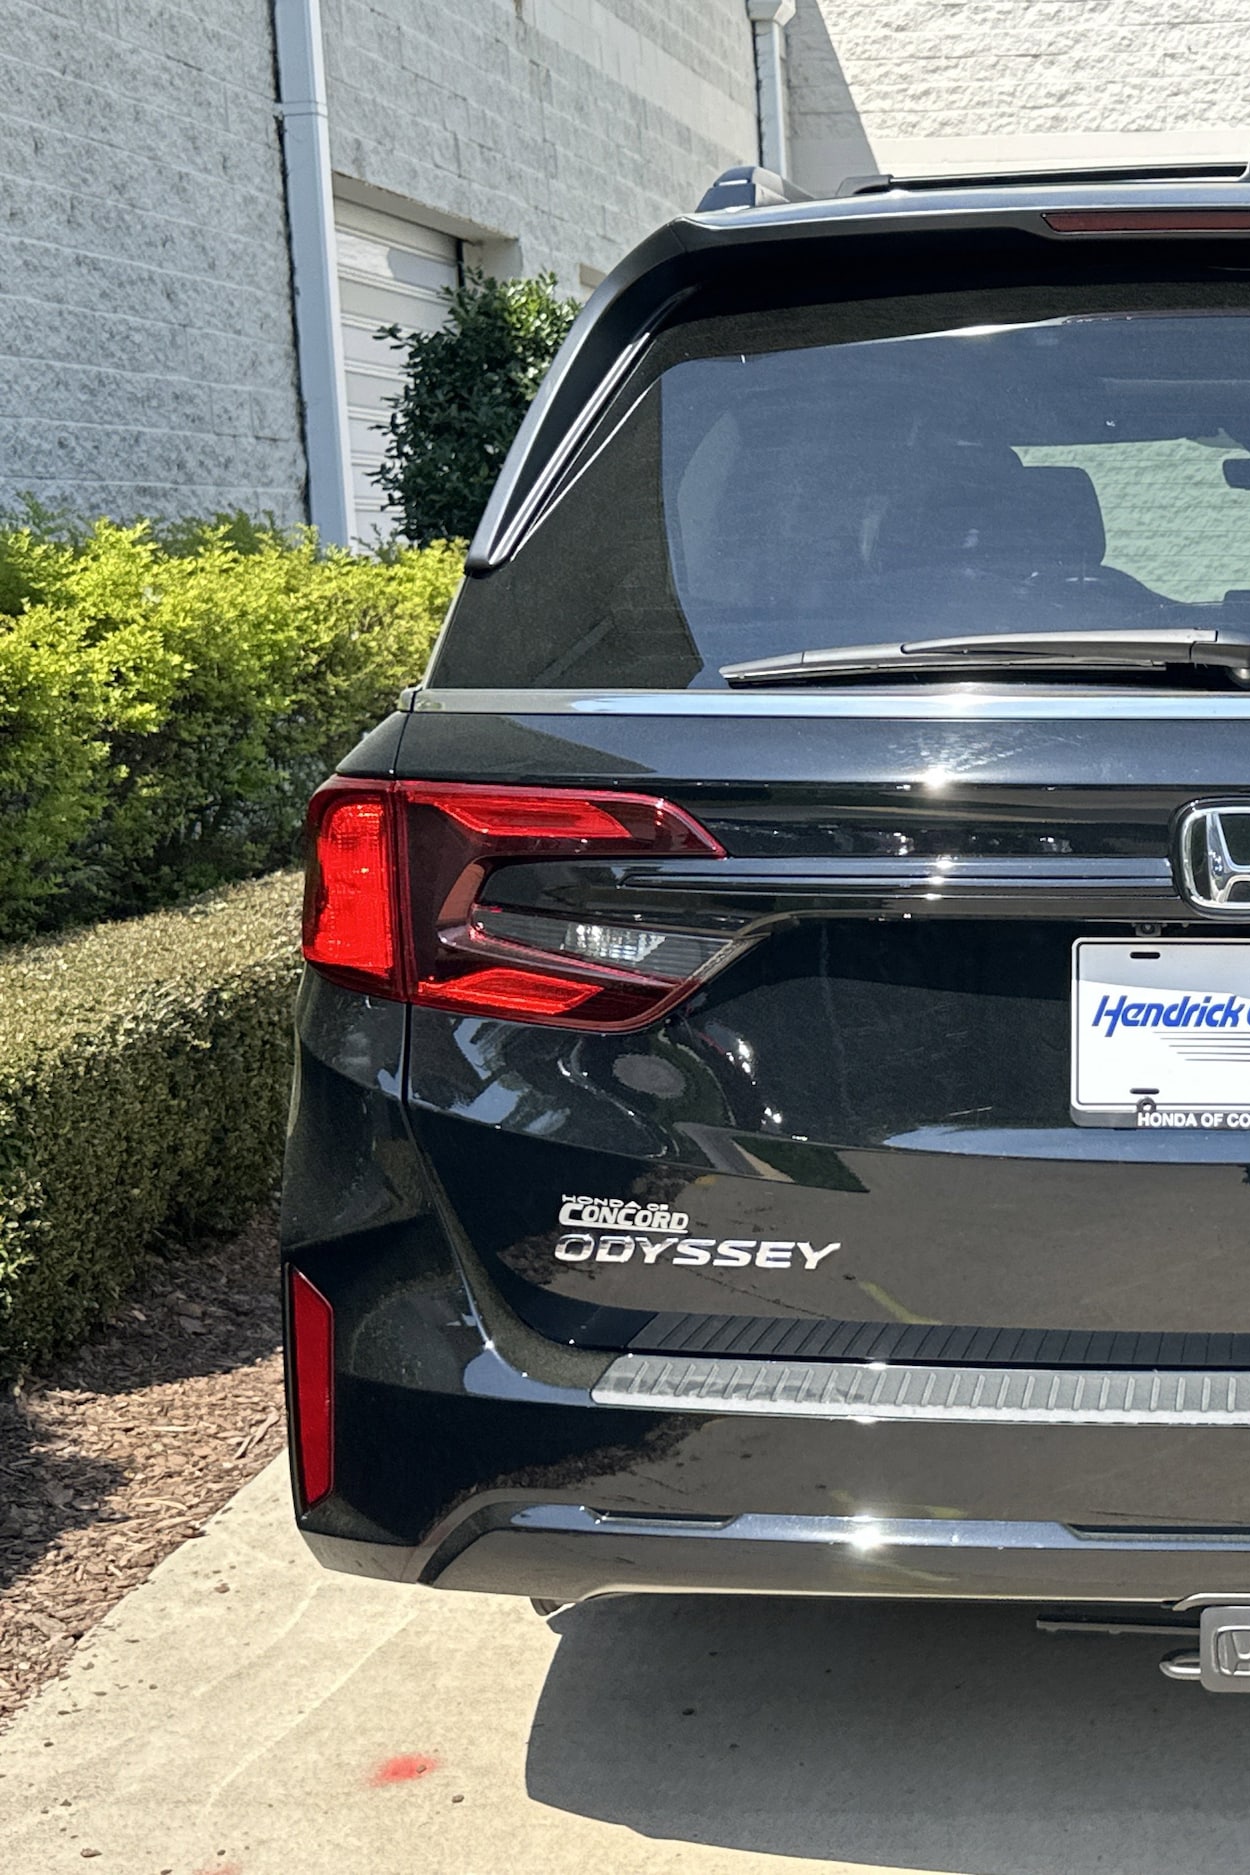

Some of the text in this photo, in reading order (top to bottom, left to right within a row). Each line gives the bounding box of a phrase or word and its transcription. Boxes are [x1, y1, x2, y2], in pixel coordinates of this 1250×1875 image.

[1138, 1112, 1197, 1127] HONDA
[1201, 1112, 1224, 1127] OF
[562, 1194, 641, 1210] HONDA
[558, 1202, 689, 1231] CONCORD
[554, 1233, 841, 1270] ODYSSEY
